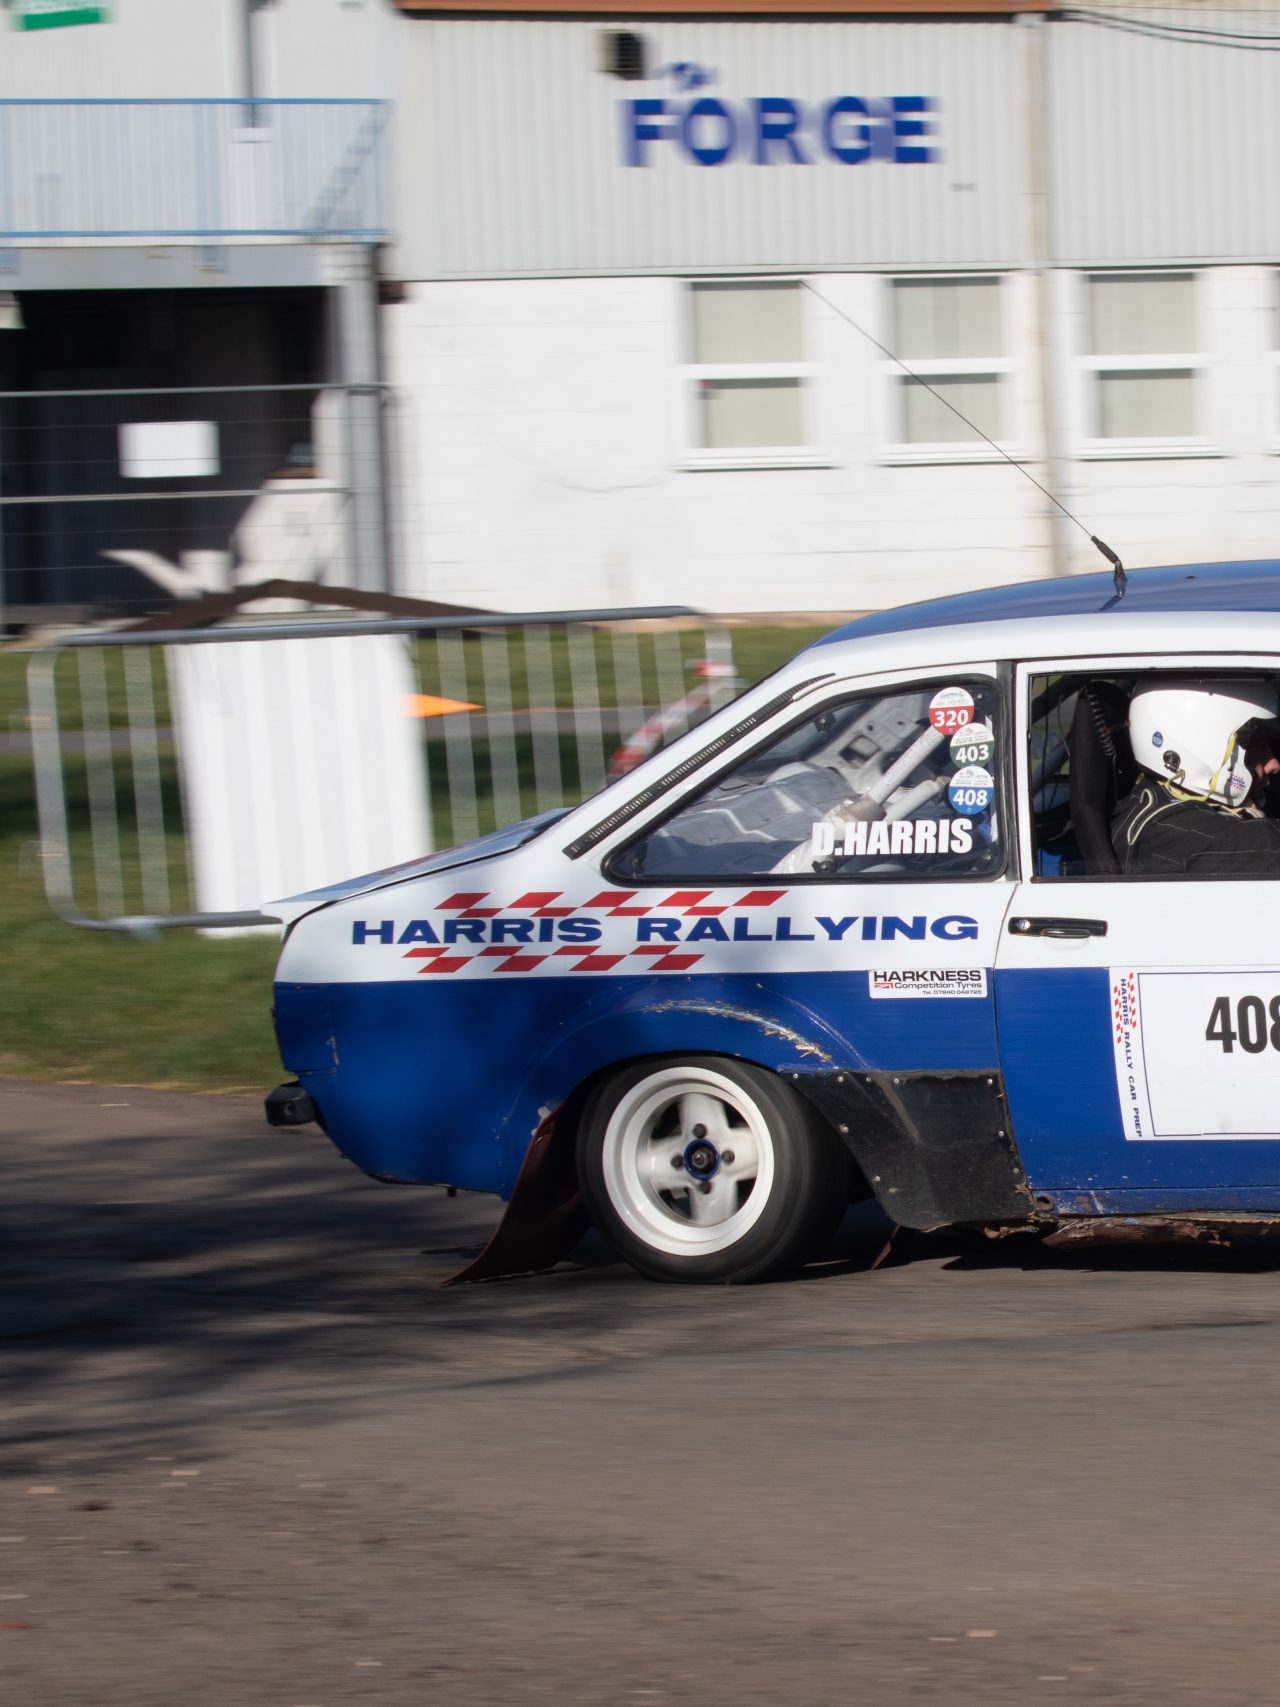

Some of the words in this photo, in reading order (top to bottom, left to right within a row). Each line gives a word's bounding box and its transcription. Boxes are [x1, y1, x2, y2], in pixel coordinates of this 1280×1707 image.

[620, 96, 944, 167] FORGE
[934, 709, 968, 727] 320
[955, 744, 989, 763] 403
[953, 789, 988, 806] 408
[811, 818, 973, 856] D.HARRIS
[352, 917, 603, 945] HARRIS
[636, 914, 979, 942] RALLYING
[874, 970, 982, 982] HARKNESS
[895, 982, 954, 990] Competition
[1121, 978, 1130, 1025] HARRIS
[1124, 1032, 1134, 1069] RALLY
[1128, 1075, 1137, 1100] CAR
[1133, 1107, 1142, 1138] PREP
